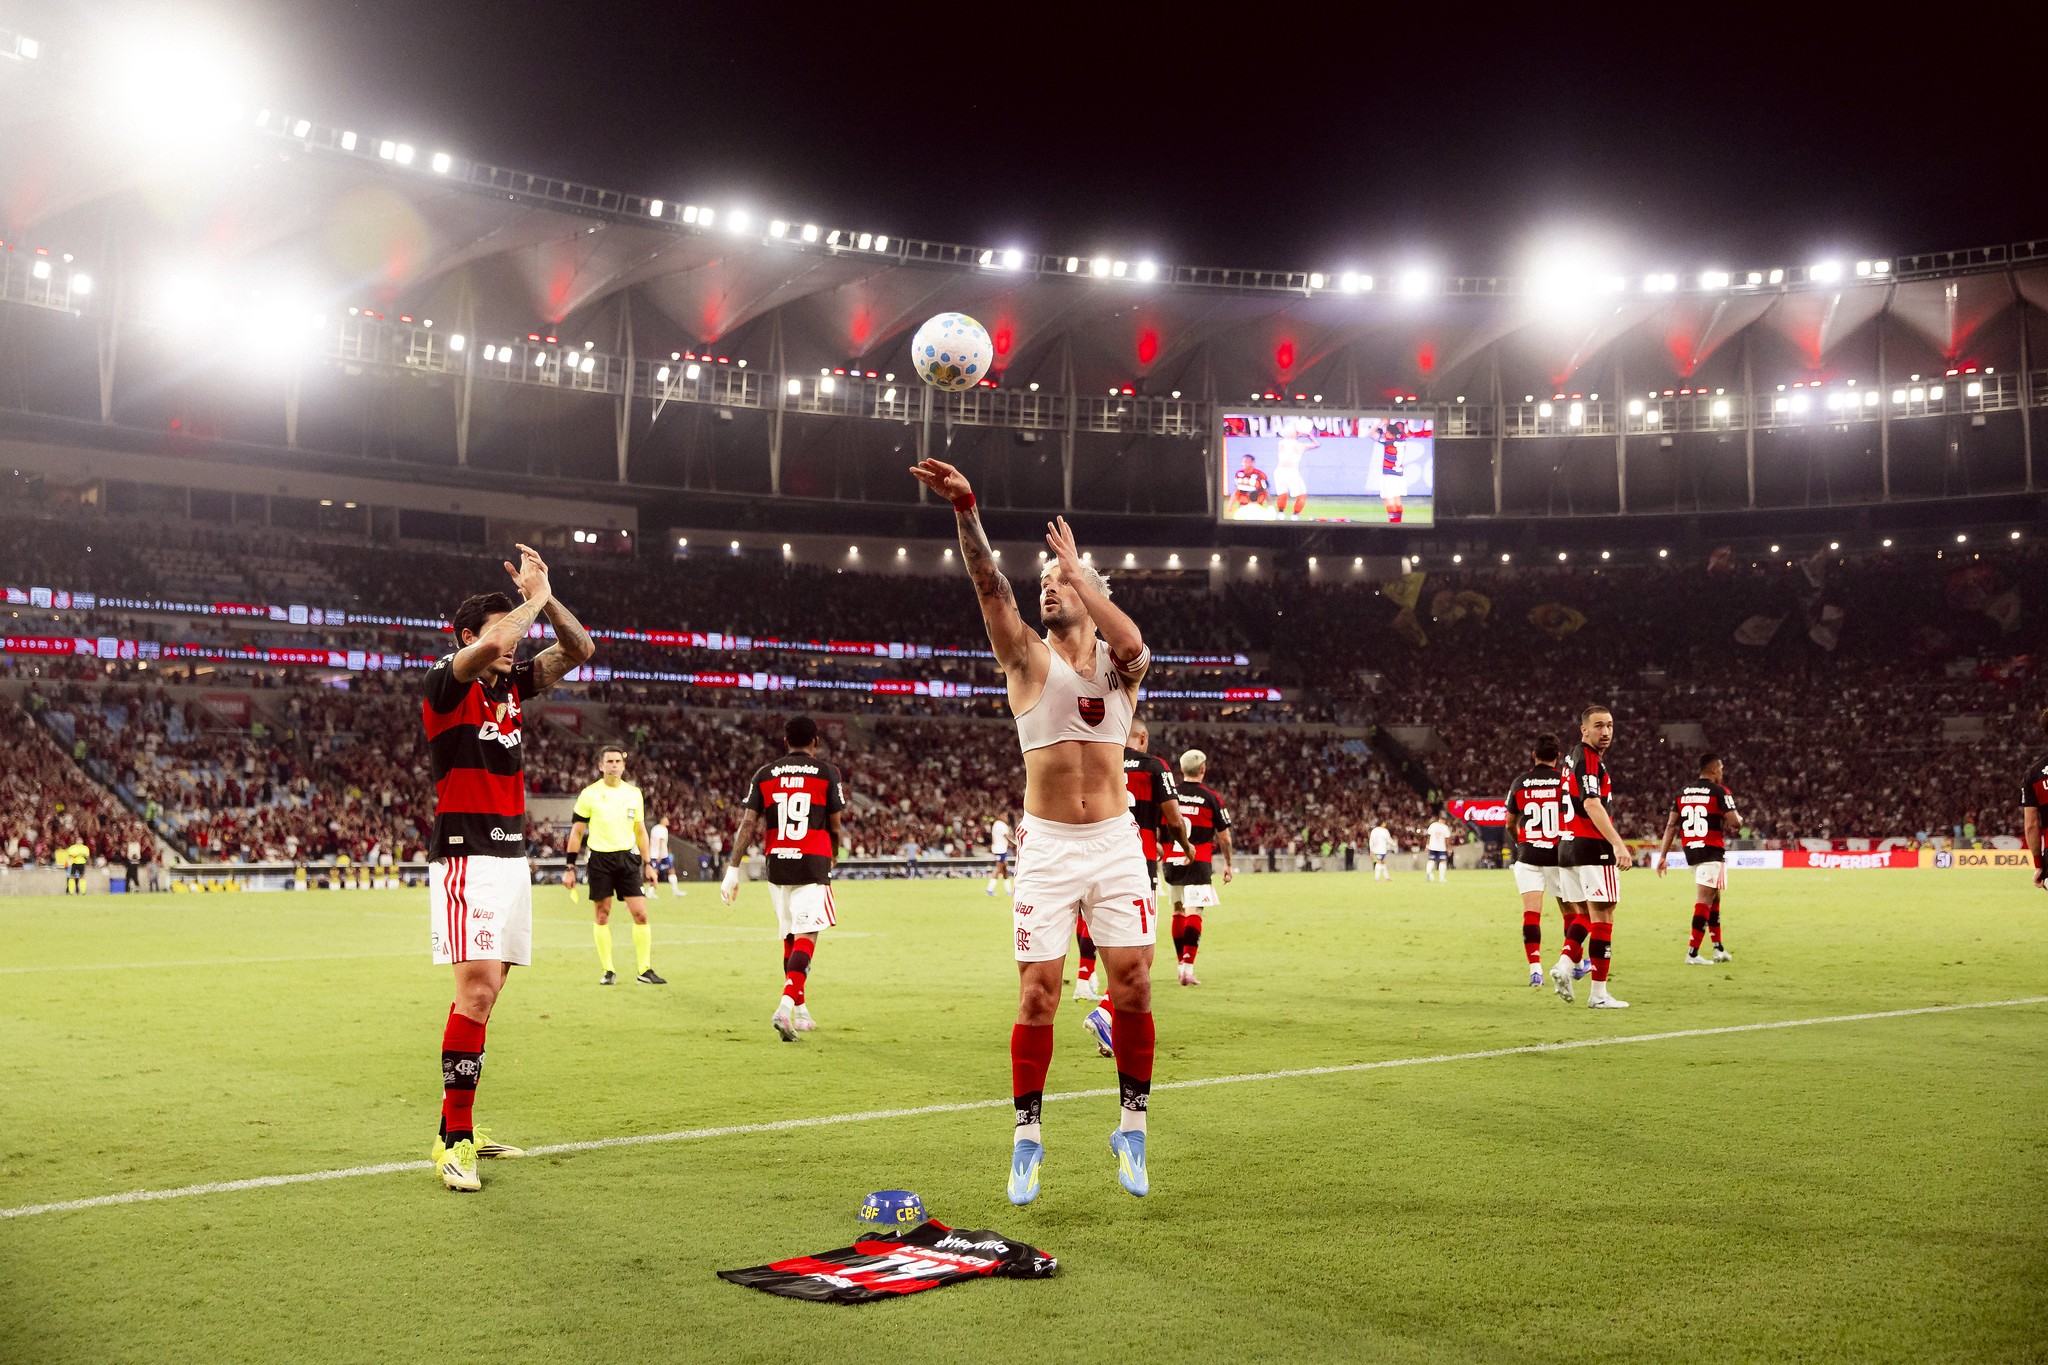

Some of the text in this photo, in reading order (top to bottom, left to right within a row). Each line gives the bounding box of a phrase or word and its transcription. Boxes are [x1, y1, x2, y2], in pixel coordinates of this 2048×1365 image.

[1104, 670, 1120, 692] 10
[781, 764, 820, 776] Hapvida
[772, 792, 811, 840] 19
[1524, 801, 1560, 839] 20
[1680, 805, 1709, 838] 26
[1808, 852, 1892, 869] SUPERBET
[1959, 855, 1988, 866] BOA
[472, 907, 494, 920] Wap
[860, 1204, 880, 1221] CBF
